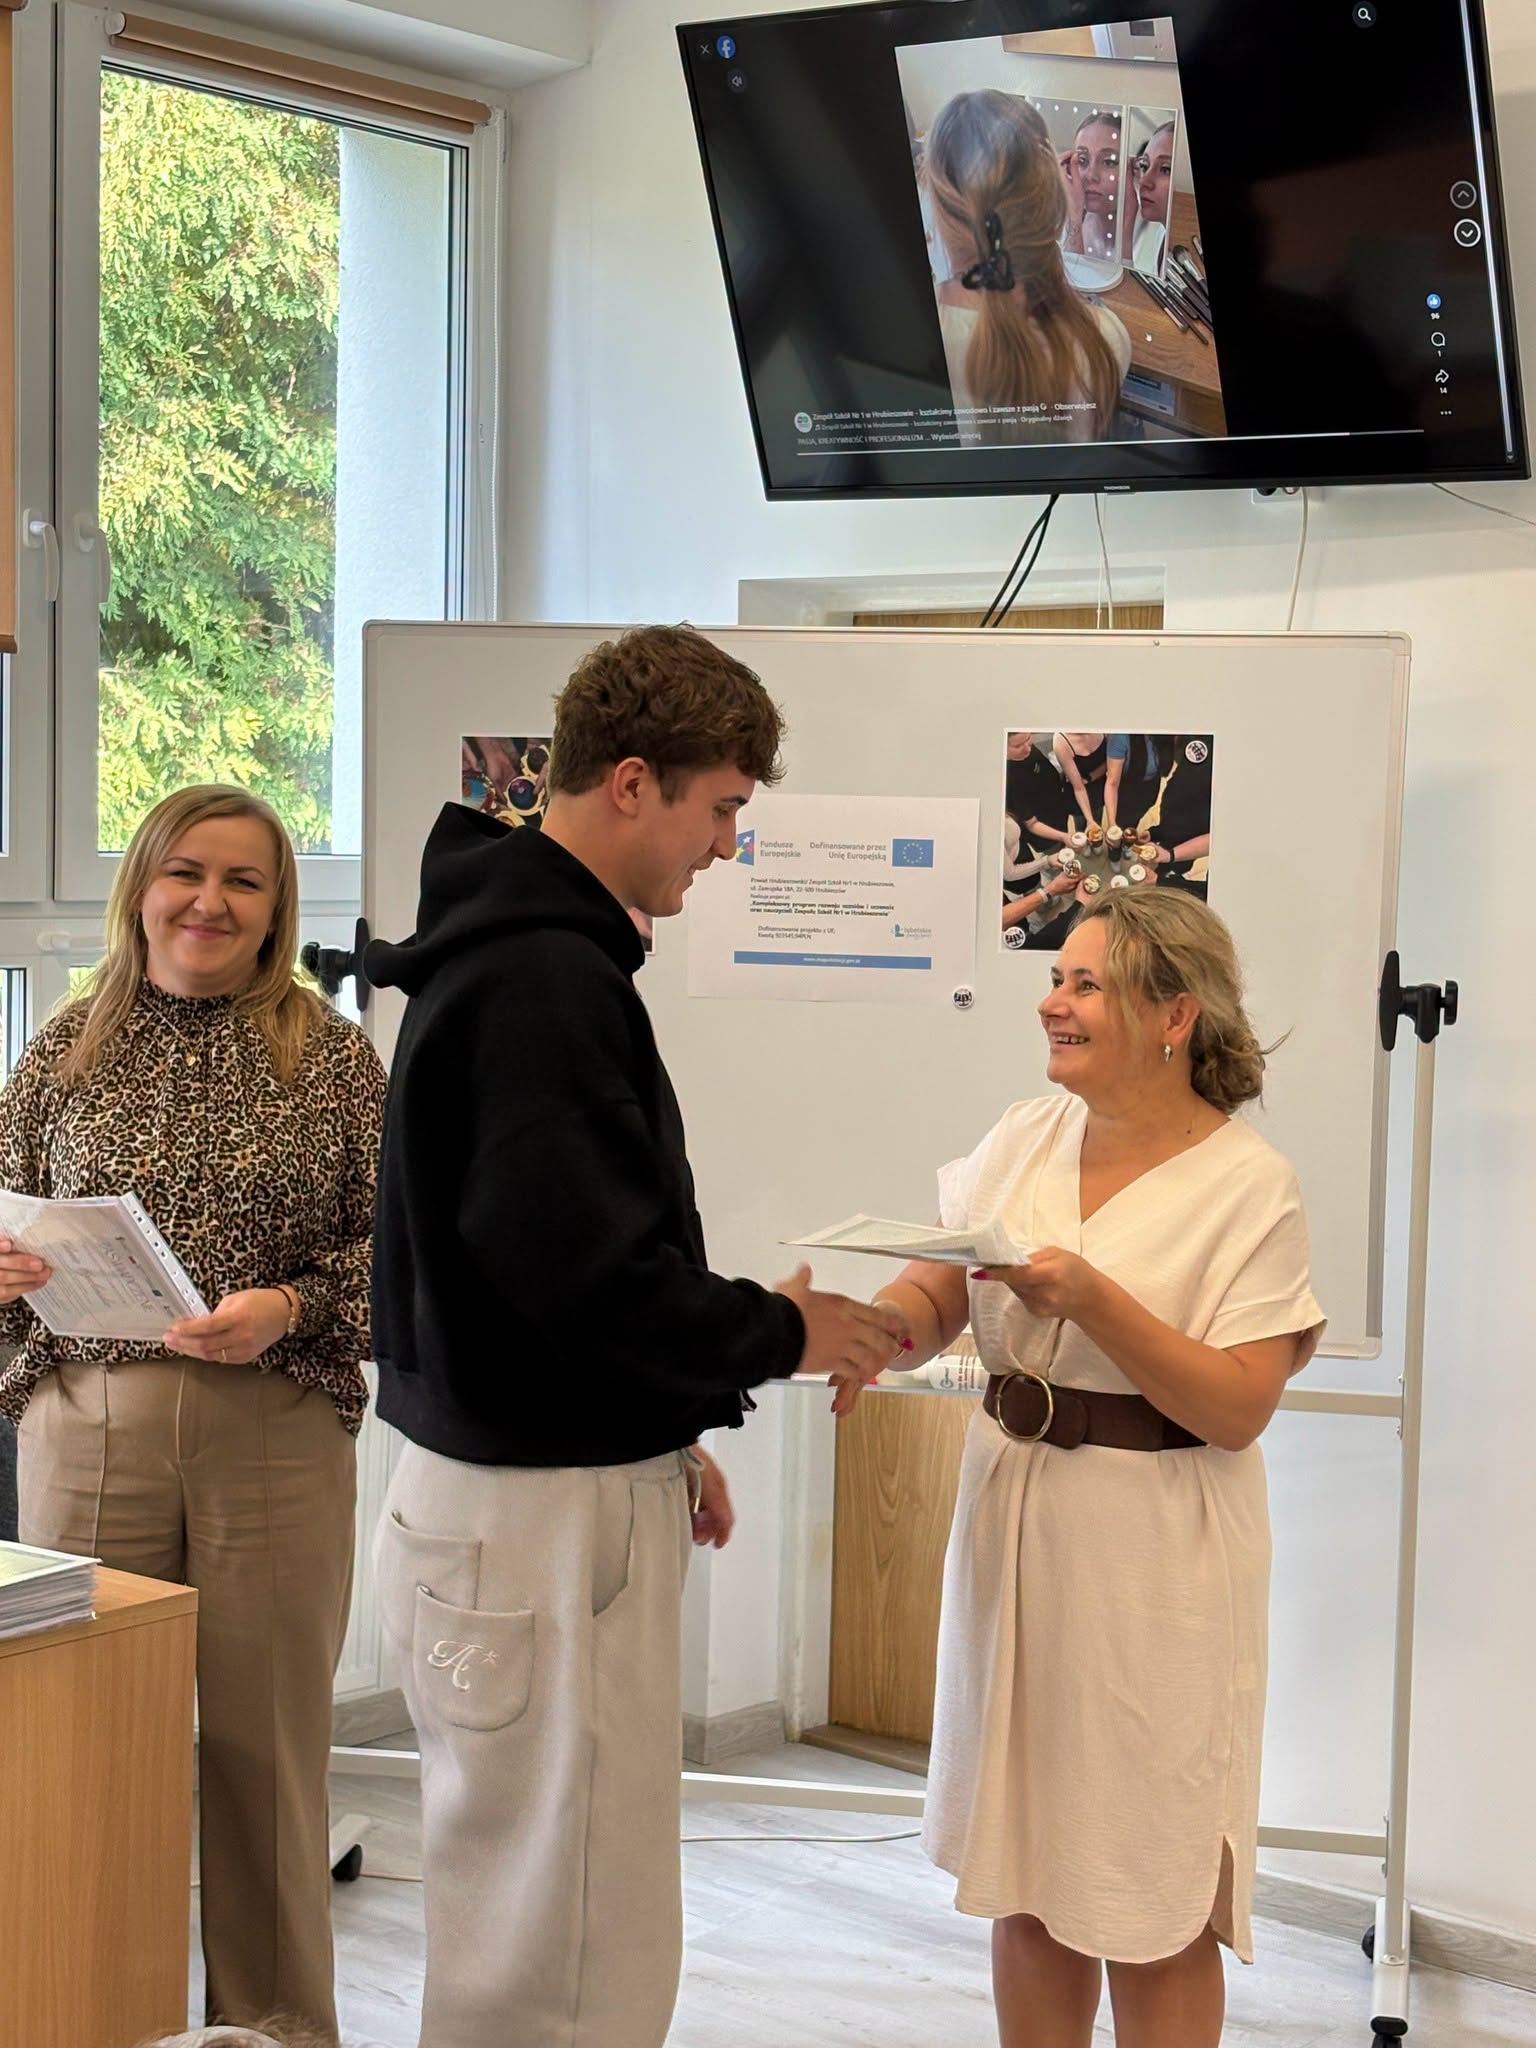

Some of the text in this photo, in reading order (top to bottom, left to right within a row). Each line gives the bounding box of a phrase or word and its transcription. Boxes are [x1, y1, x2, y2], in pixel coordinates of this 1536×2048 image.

[1054, 402, 1097, 411] Obserwujesz
[760, 840, 794, 848] Fundusze
[810, 841, 886, 852] Dofinansowane przez
[760, 850, 801, 859] Europejskie
[828, 851, 886, 862] Unię Europejską
